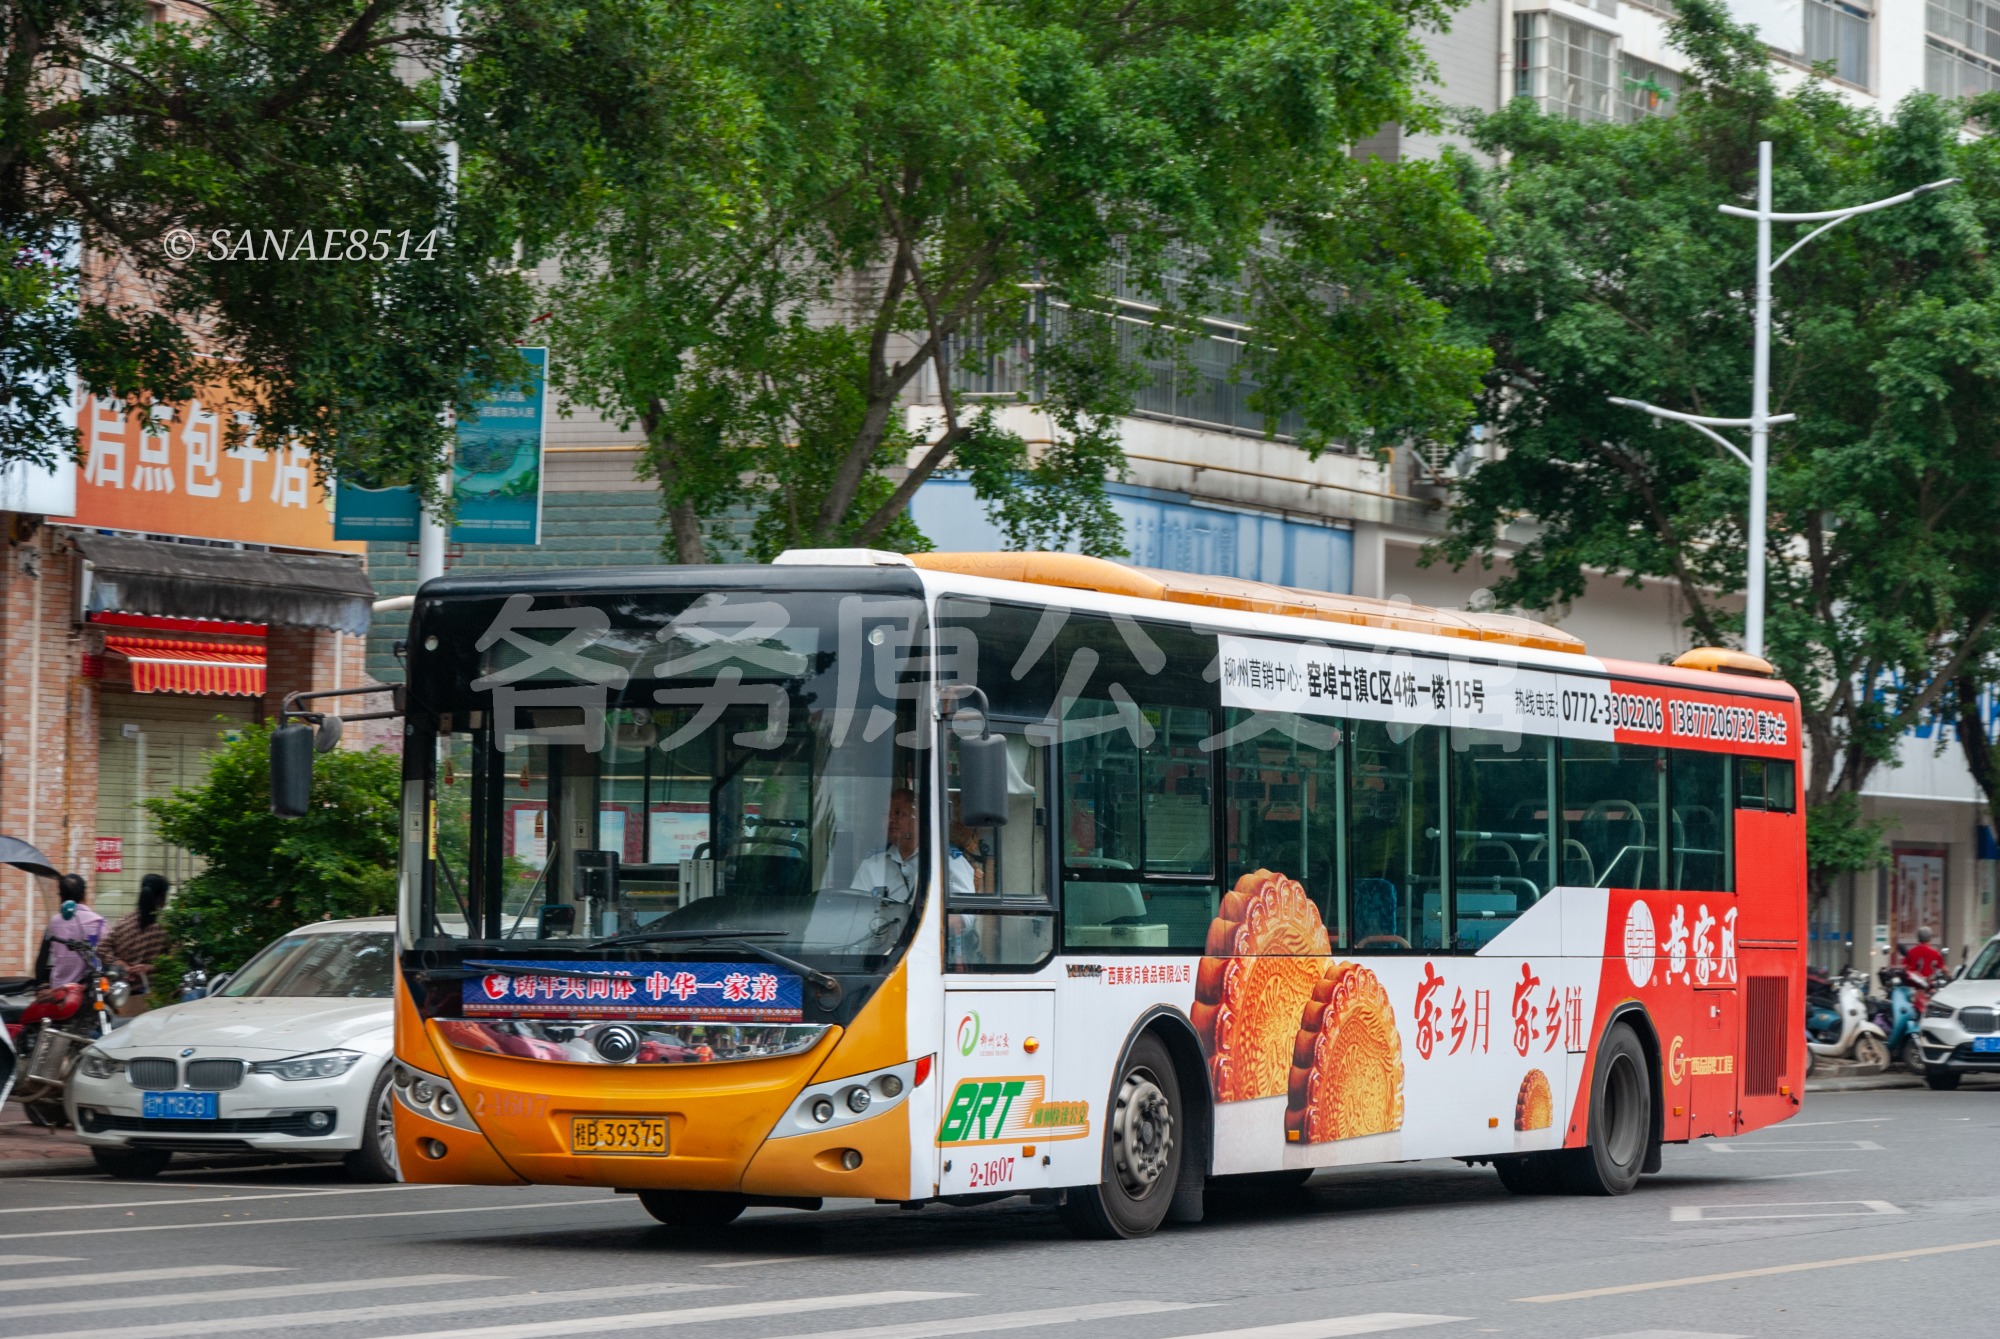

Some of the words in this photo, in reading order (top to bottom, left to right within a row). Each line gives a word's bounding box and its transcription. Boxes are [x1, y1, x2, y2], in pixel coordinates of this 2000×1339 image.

[1306, 660, 1486, 714] 窑埠古镇C区4栋一楼115号
[1514, 688, 1559, 718] 热线电话:
[1562, 689, 1663, 733] 0772-3302206
[1669, 699, 1756, 741] 13877206732
[645, 971, 779, 1002] 中华一家亲
[1098, 965, 1191, 985] 广西黄家月食品有限公司
[1683, 1055, 1734, 1076] 广西品牌工程
[937, 1081, 1025, 1142] BRT
